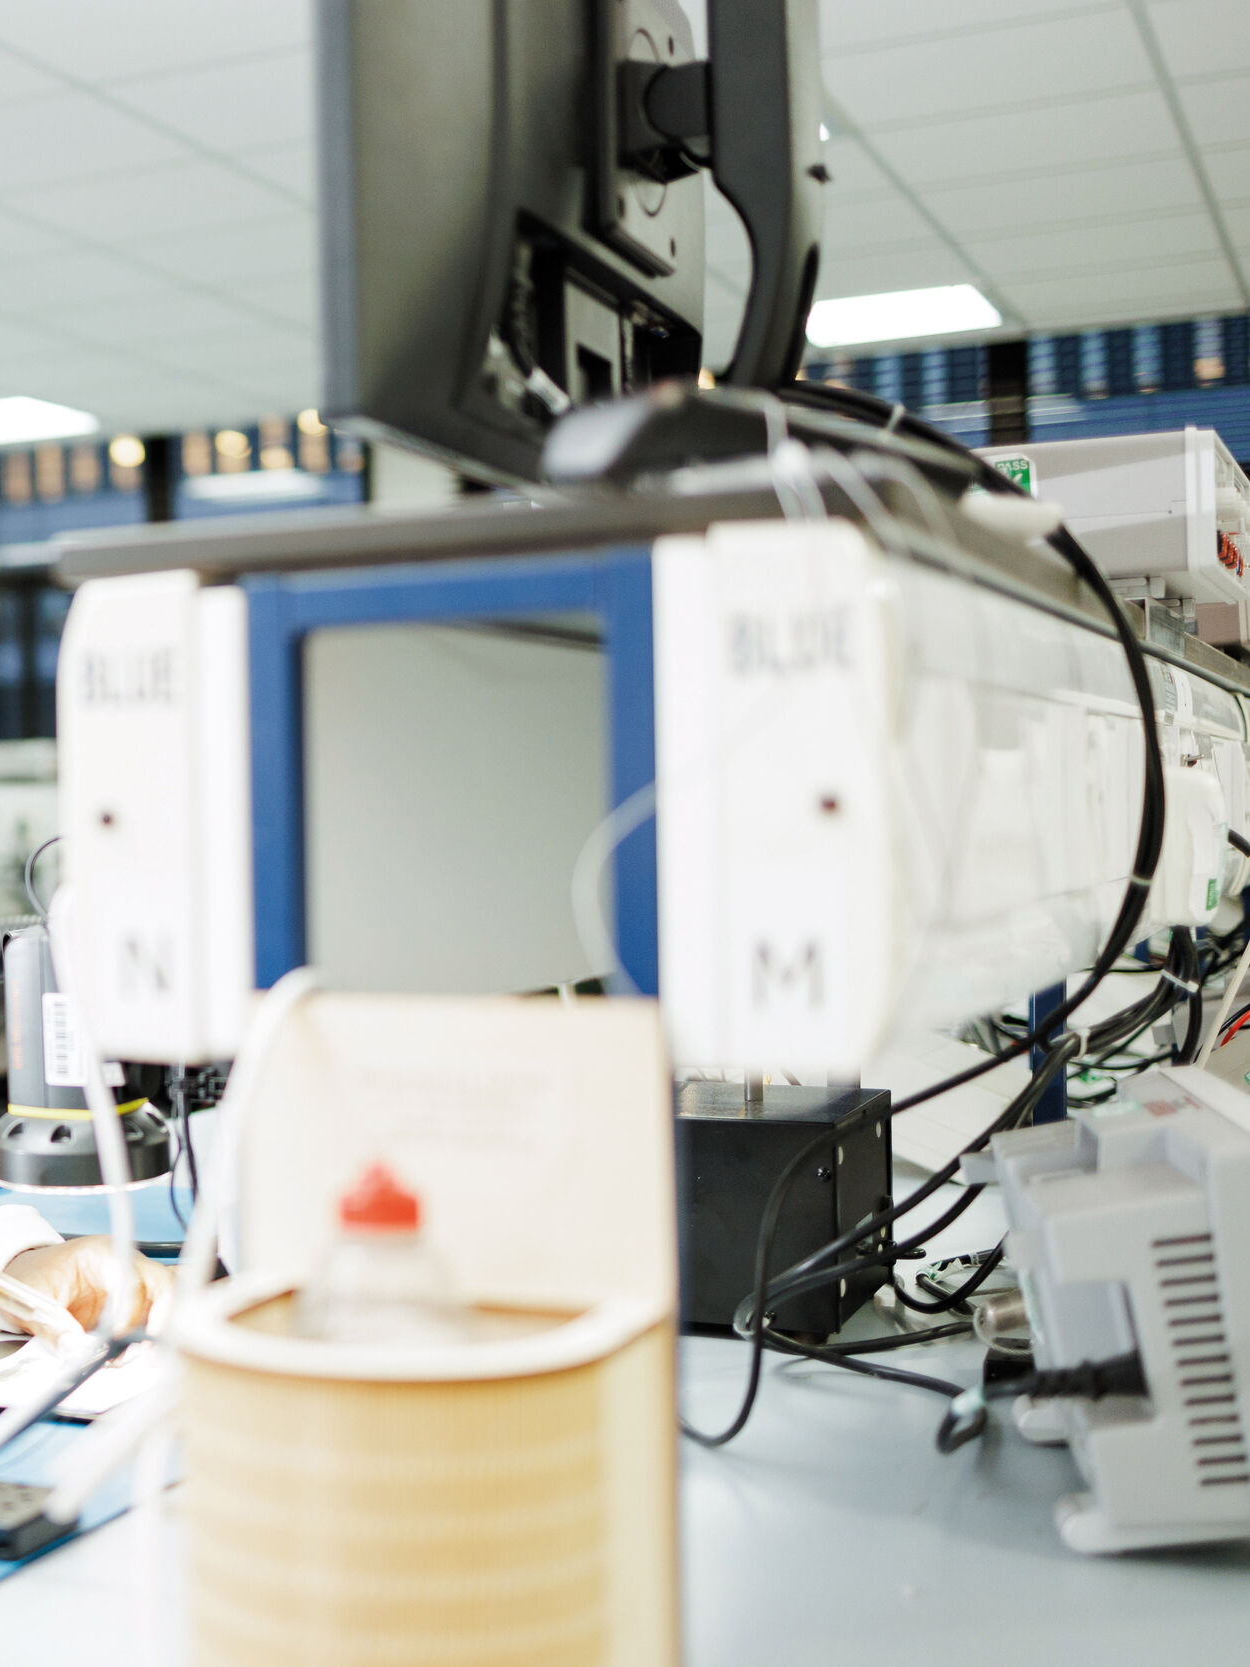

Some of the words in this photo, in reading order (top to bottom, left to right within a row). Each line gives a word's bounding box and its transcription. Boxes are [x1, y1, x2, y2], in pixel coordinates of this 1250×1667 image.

[725, 604, 854, 676] BLUE
[80, 647, 176, 706] BLUE
[120, 931, 171, 998] N
[751, 938, 826, 1008] M
